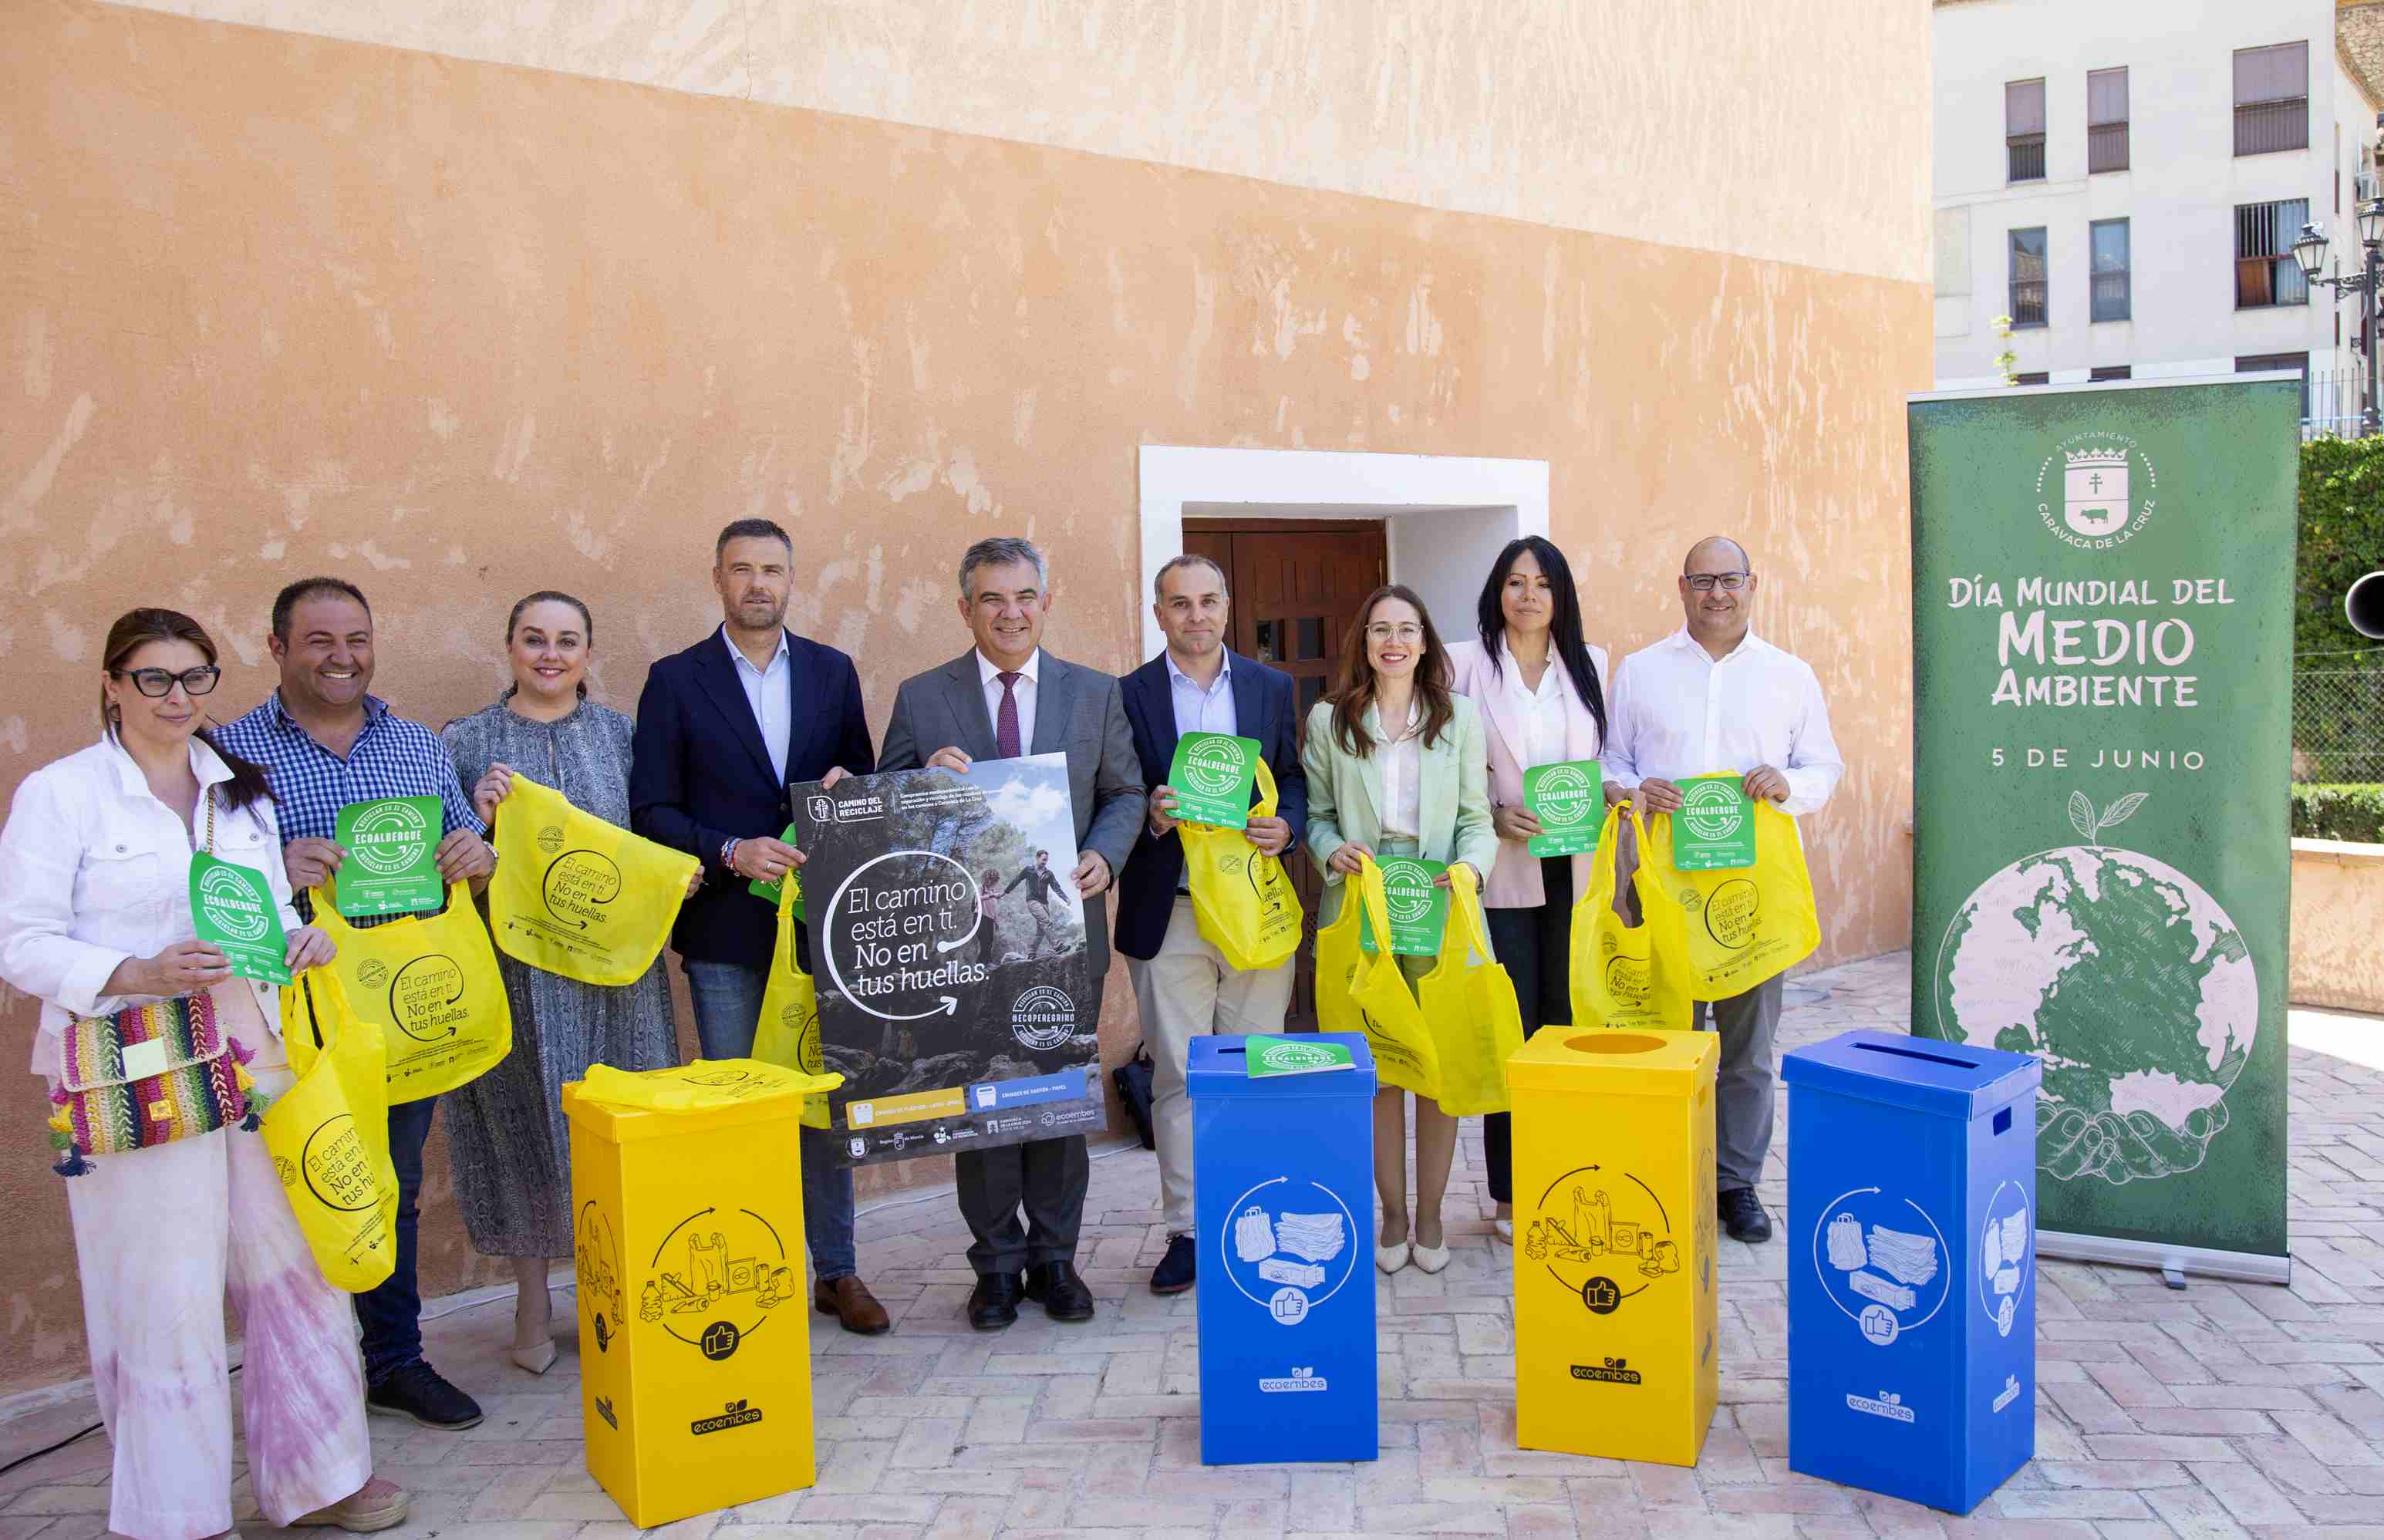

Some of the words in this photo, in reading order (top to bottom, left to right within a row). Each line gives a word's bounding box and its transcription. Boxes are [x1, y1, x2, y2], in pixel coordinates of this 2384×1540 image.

[2056, 431, 2137, 450] AYUNTAMIENTO
[2038, 502, 2092, 549] CARAVACA
[2096, 537, 2113, 549] DE
[2116, 531, 2133, 544] LA
[2133, 500, 2155, 532] CRUZ
[2017, 577, 2158, 607] MUNDIAL
[2172, 578, 2235, 605] DEL
[1998, 610, 2194, 666] MEDIO
[1991, 668, 2197, 706] AMBIENTE
[1189, 757, 1240, 774] ECOALBERGUE
[1992, 749, 2004, 767] 5
[2028, 749, 2068, 767] DE
[2091, 750, 2204, 770] JUNIO
[838, 799, 867, 808] CAMINO
[868, 797, 882, 805] DEL
[1538, 790, 1588, 801] ECOALBERGUE
[839, 805, 883, 817] RECICLAJE
[1687, 806, 1738, 815] ECOALBERGUE
[355, 831, 421, 844] ECOALBERGUE
[562, 857, 574, 871] El
[575, 864, 617, 887] camino
[553, 881, 571, 897] No
[573, 890, 587, 901] en
[581, 879, 597, 891] en
[1383, 887, 1429, 898] OALBERGUE
[204, 895, 263, 913] ECOALBERGUE
[549, 893, 566, 908] tus
[848, 888, 869, 914] El
[876, 880, 966, 910] camino
[851, 912, 897, 941] está
[904, 913, 933, 935] en
[939, 905, 957, 930] ti.
[1719, 921, 1733, 933] No
[1735, 915, 1747, 925] en
[1722, 931, 1737, 943] tus
[855, 942, 891, 969] No
[898, 942, 928, 964] en
[400, 976, 412, 990] El
[414, 969, 457, 987] camino
[857, 974, 894, 996] tus
[901, 961, 990, 991] huellas.
[403, 990, 428, 1004] está
[430, 985, 444, 998] en
[407, 1005, 426, 1019] No
[428, 1001, 442, 1014] en
[410, 1019, 428, 1032] tus
[430, 1007, 469, 1027] huellas.
[1012, 1014, 1074, 1023] #ECOPEREGRINO
[1055, 1108, 1095, 1120] ecoembes
[308, 1155, 324, 1173] El
[322, 1125, 359, 1162] camin
[345, 1146, 360, 1163] en
[330, 1174, 352, 1195] No
[352, 1160, 368, 1178] en
[342, 1185, 364, 1206] tus
[1263, 1379, 1324, 1389] ecoembes
[1573, 1367, 1639, 1382] ecoembes
[1850, 1397, 1913, 1420] ecoembes
[693, 1411, 760, 1434] ecoembes
